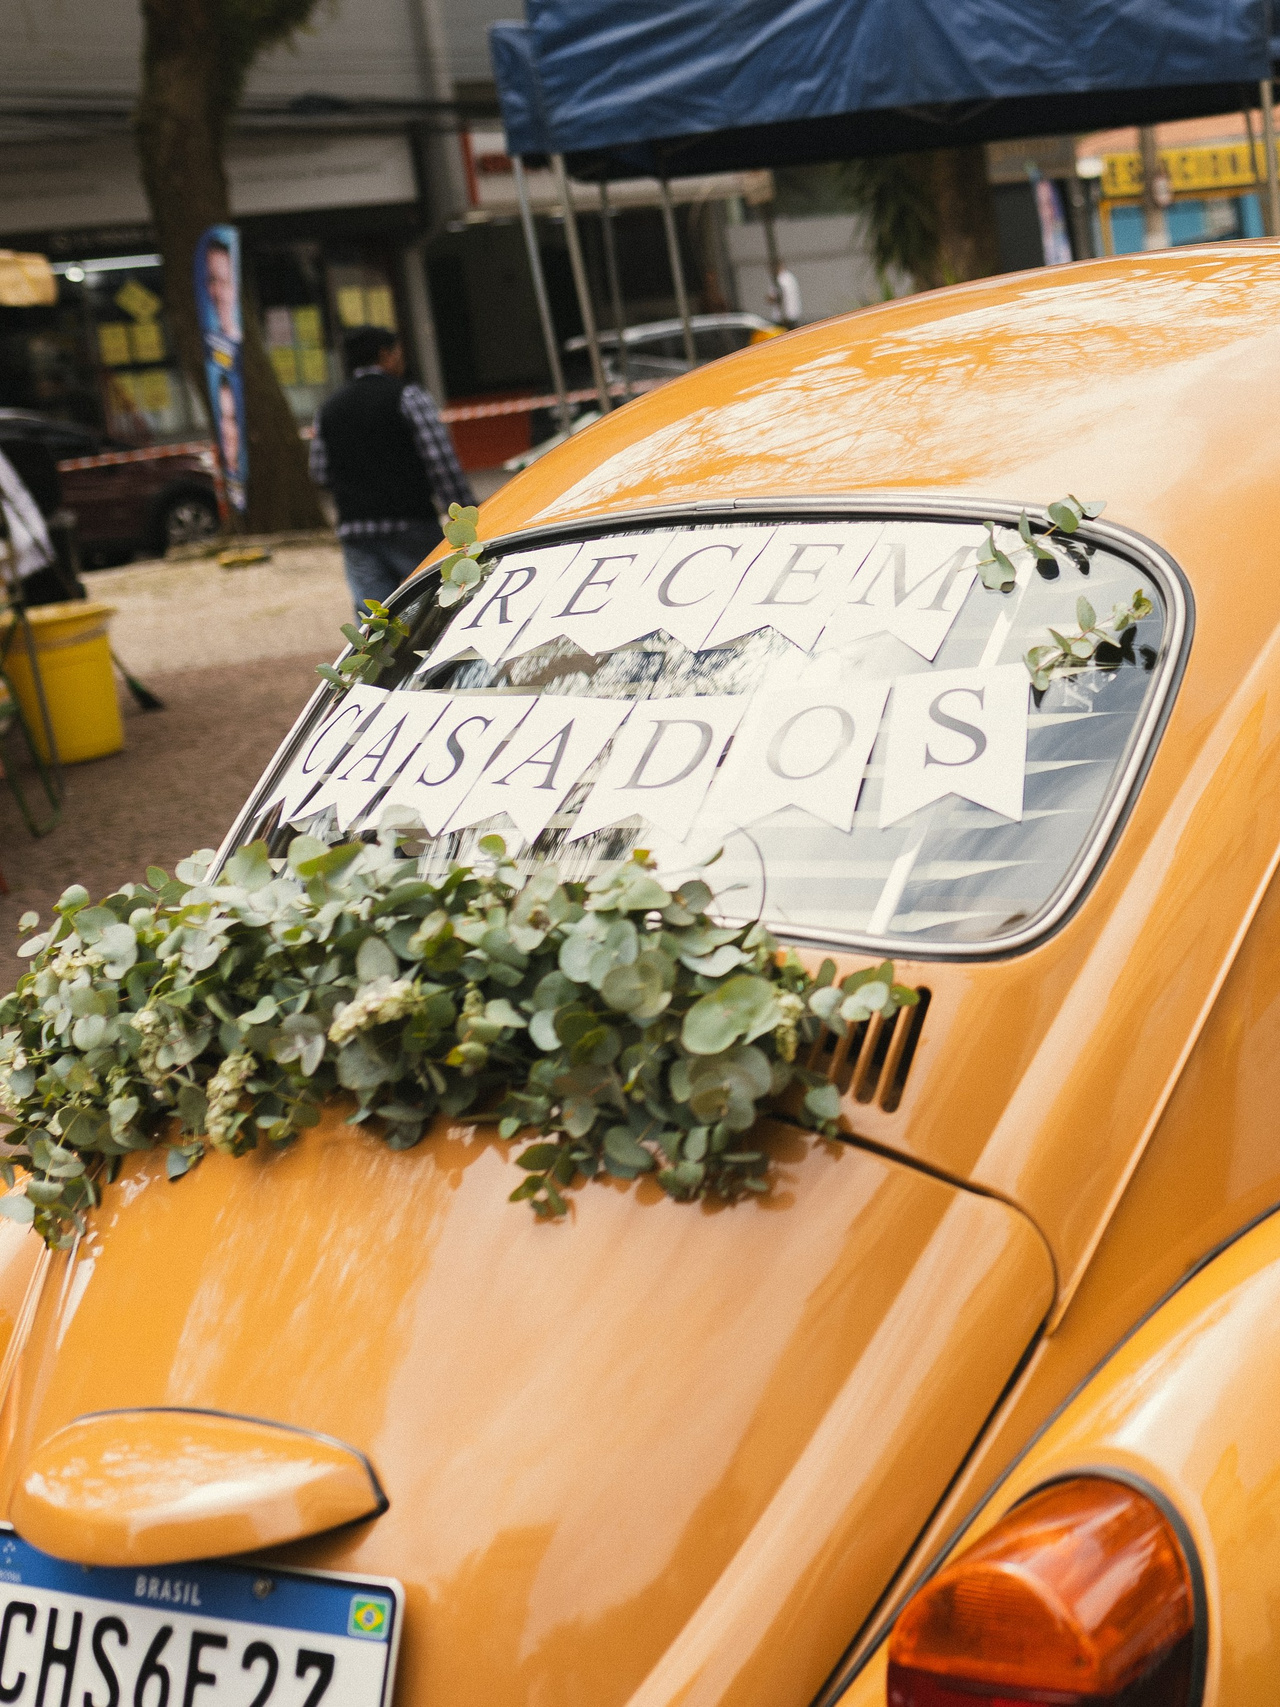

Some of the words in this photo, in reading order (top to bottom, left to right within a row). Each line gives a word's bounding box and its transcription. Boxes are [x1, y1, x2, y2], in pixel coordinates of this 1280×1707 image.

[460, 542, 980, 630] RECEM
[301, 685, 989, 791] CASADOS
[134, 1574, 202, 1607] BRASIL
